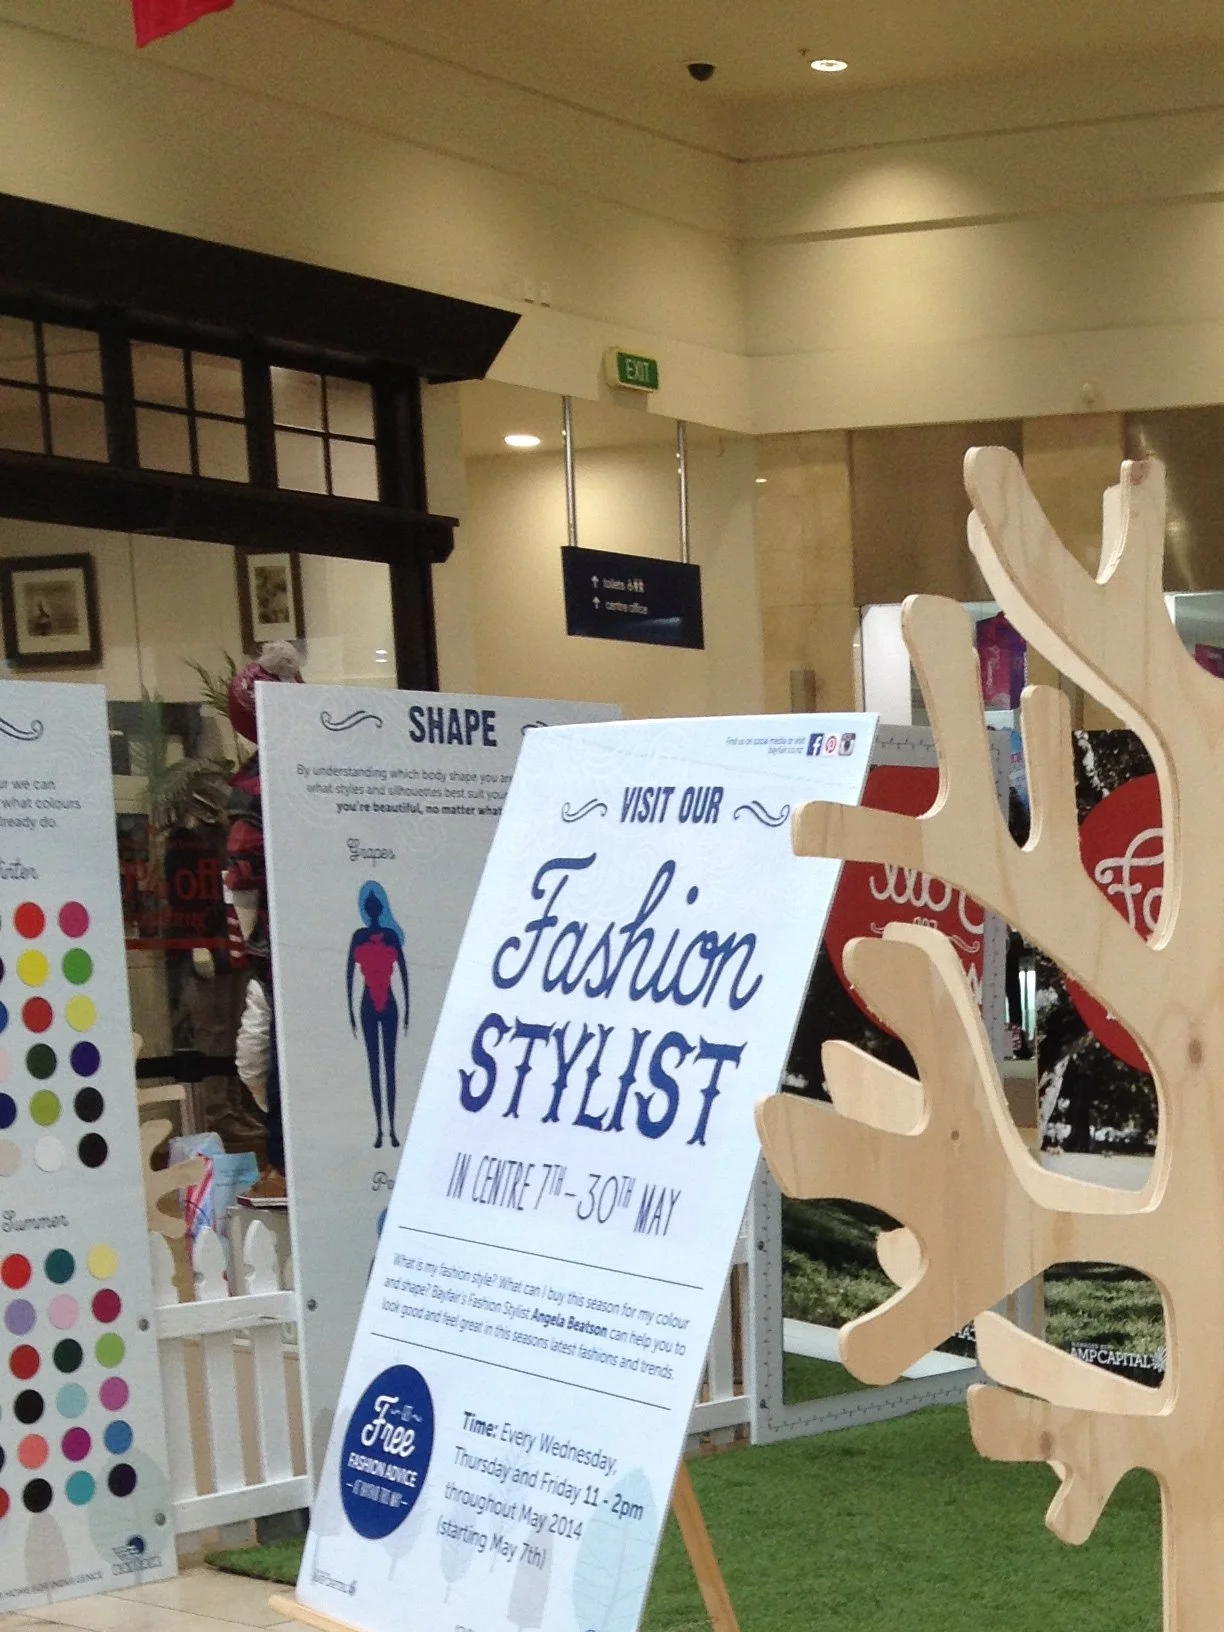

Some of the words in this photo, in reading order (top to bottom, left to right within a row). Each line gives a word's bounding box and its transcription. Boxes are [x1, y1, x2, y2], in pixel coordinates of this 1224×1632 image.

[625, 358, 650, 383] EXIT
[605, 601, 628, 613] centre
[628, 604, 648, 615] office
[408, 705, 498, 747] SHAPE
[12, 779, 30, 791] we
[32, 780, 56, 791] can
[297, 764, 310, 779] By
[312, 767, 387, 781] understanding
[389, 767, 420, 780] which
[421, 769, 446, 783] body
[449, 770, 477, 785] shape
[479, 774, 499, 785] you
[306, 784, 333, 794] what
[335, 784, 365, 797] styles
[366, 786, 386, 796] and
[388, 785, 442, 798] silhouettes
[444, 787, 464, 798] best
[467, 788, 484, 799] suit
[35, 797, 82, 810] colours
[336, 800, 370, 814] you're
[372, 803, 423, 816] beautiful,
[425, 805, 440, 815] no
[441, 804, 475, 815] matter
[620, 786, 673, 824] VISIT
[681, 785, 724, 824] OUR
[346, 838, 396, 868] Grapes
[491, 852, 764, 1010] Fashion
[458, 1012, 748, 1146] STYLIST
[446, 1151, 473, 1200] IN
[471, 1155, 536, 1212] CENTRE
[632, 1182, 682, 1237] MAY
[1, 1209, 71, 1234] Summer
[393, 1252, 417, 1270] What
[415, 1260, 425, 1272] is
[424, 1261, 439, 1278] my
[439, 1262, 472, 1281] fashion
[471, 1271, 499, 1289] style?
[498, 1275, 523, 1294] What
[523, 1284, 542, 1298] can
[547, 1287, 565, 1306] buy
[566, 1291, 586, 1308] this
[585, 1298, 620, 1315] season
[620, 1302, 638, 1318] for
[637, 1308, 656, 1326] my
[655, 1312, 691, 1331] colour
[383, 1277, 401, 1291] and
[400, 1278, 431, 1298] shape?
[468, 1292, 502, 1313] Fashion
[501, 1300, 531, 1320] Stylist
[530, 1306, 567, 1329] Angela
[566, 1315, 609, 1338] Beatson
[608, 1327, 630, 1343] can
[629, 1330, 652, 1351] help
[650, 1338, 675, 1354] you
[673, 1341, 687, 1357] to
[380, 1297, 400, 1312] look
[400, 1303, 425, 1319] good
[423, 1309, 442, 1324] and
[441, 1311, 460, 1327] feel
[458, 1317, 484, 1334] great
[482, 1323, 494, 1336] in
[493, 1324, 512, 1341] this
[511, 1331, 550, 1350] seasons
[549, 1336, 578, 1357] latest
[577, 1343, 619, 1367] fashions
[618, 1355, 641, 1372] and
[640, 1359, 675, 1381] trends.
[361, 1395, 415, 1458] Free
[462, 1410, 499, 1438] Time:
[499, 1422, 537, 1454] Every
[538, 1432, 619, 1478] Wednesday,
[346, 1451, 387, 1478] FASHION
[384, 1463, 418, 1488] ADVICE
[453, 1445, 513, 1485] Thursday
[511, 1467, 540, 1489] and
[540, 1471, 582, 1506] Friday
[582, 1484, 601, 1508] 11
[611, 1492, 645, 1521] 2pm
[444, 1481, 518, 1521] throughout
[517, 1502, 549, 1534] May
[549, 1513, 584, 1541] 2014
[436, 1514, 489, 1554] (starting
[488, 1532, 519, 1564] May
[519, 1541, 547, 1571] 7th)
